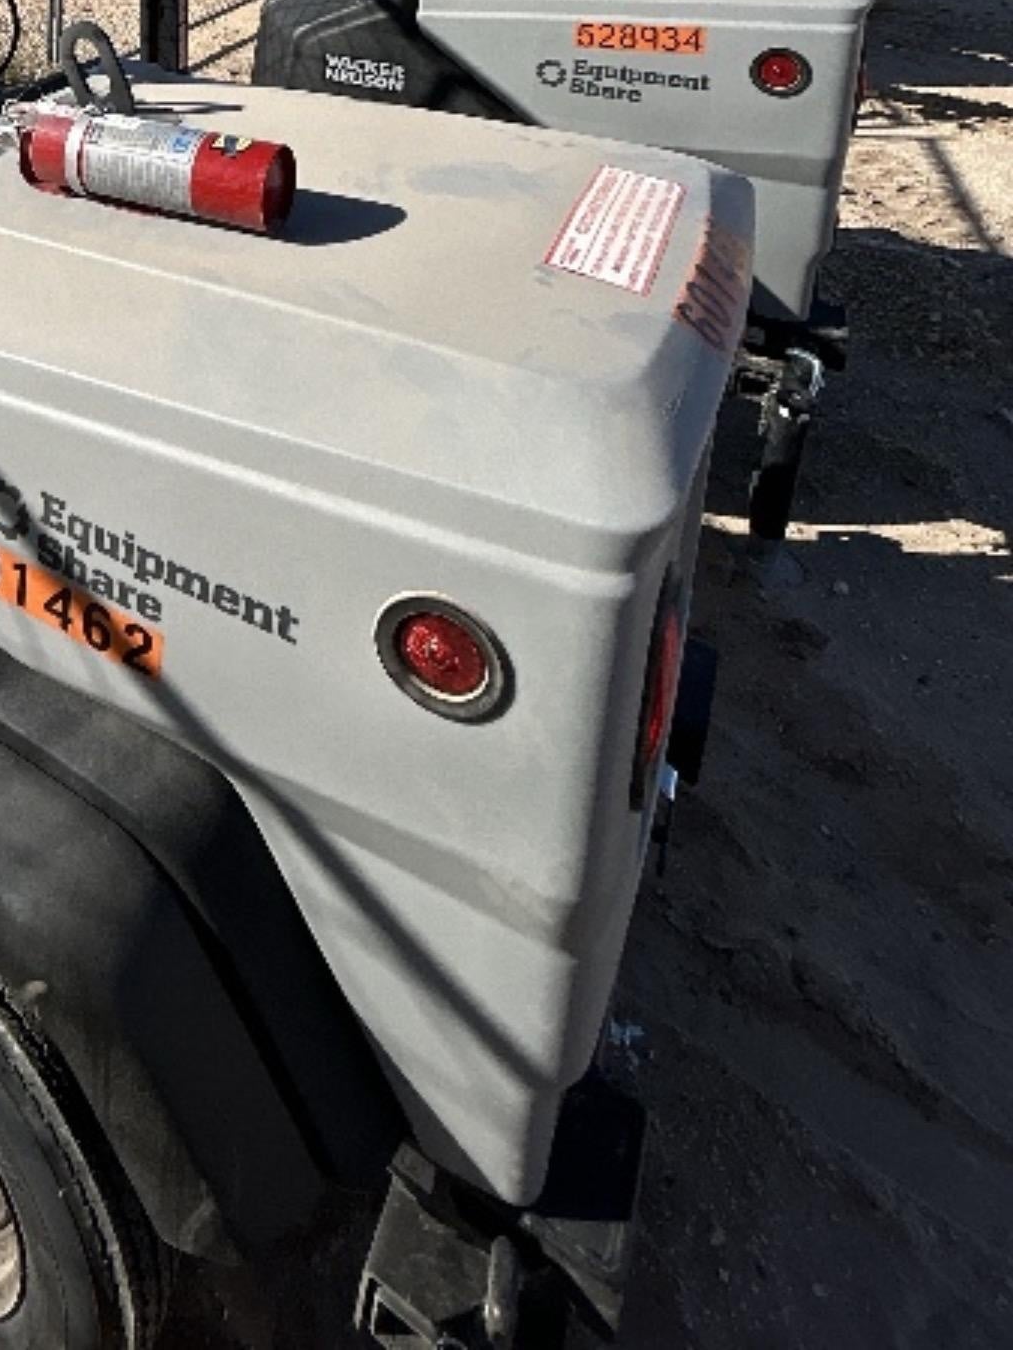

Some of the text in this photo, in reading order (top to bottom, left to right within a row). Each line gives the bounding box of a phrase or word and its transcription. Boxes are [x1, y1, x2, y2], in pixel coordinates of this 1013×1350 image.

[576, 22, 704, 52] 528934
[569, 77, 643, 102] Share
[573, 59, 711, 91] Equipment
[35, 532, 163, 623] Share
[39, 490, 301, 645] Equipment
